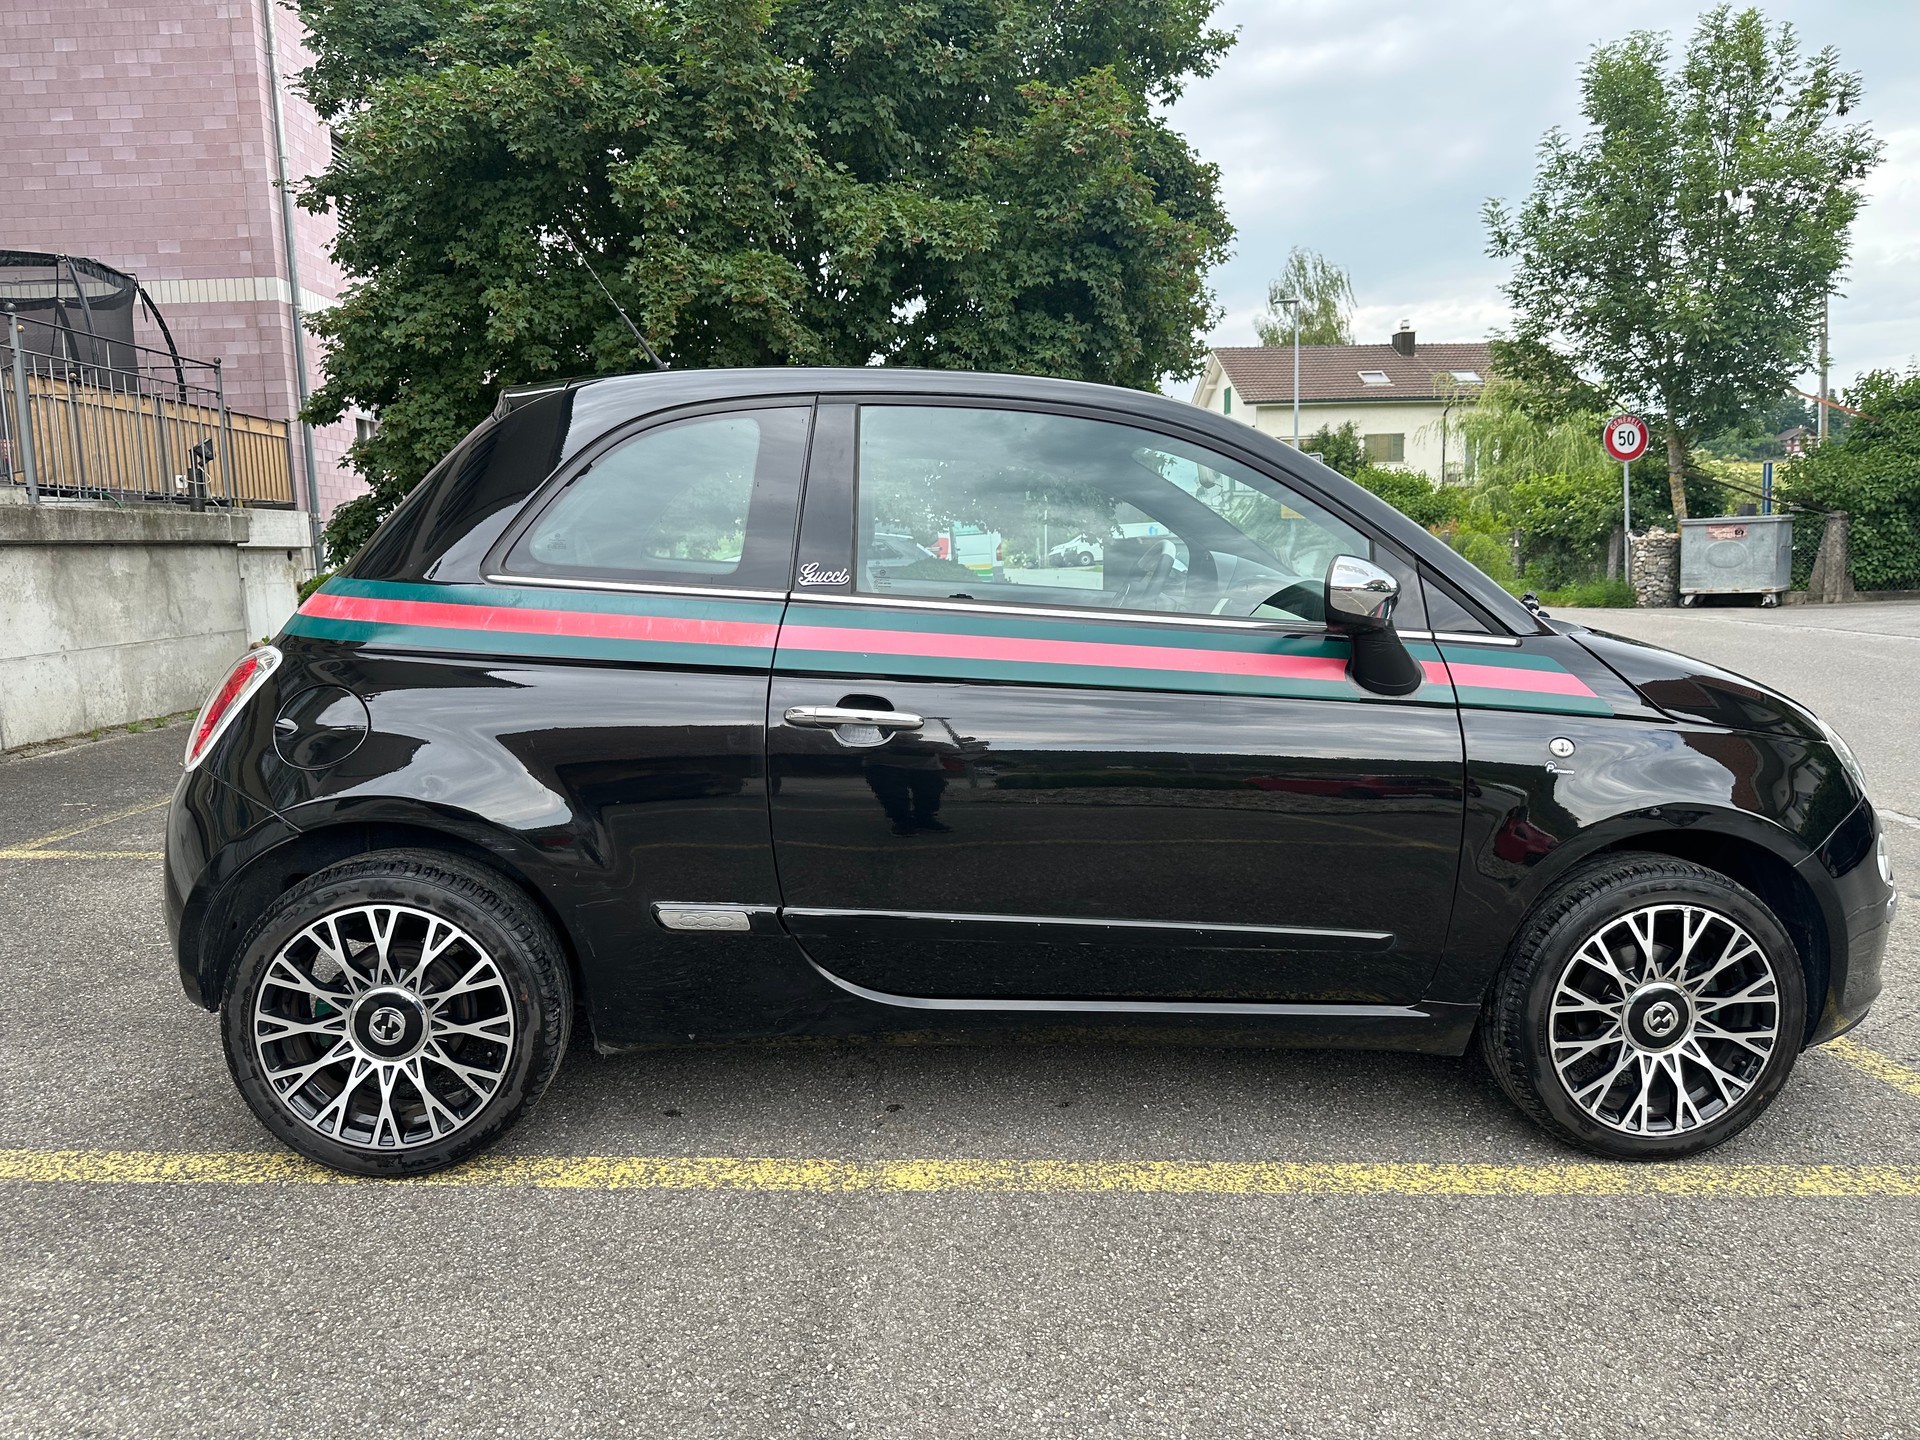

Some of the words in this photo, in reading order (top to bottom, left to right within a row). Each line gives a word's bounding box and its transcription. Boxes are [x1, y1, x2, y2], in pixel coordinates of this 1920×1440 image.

[1610, 416, 1642, 430] GENERELL
[1618, 430, 1635, 446] 50
[798, 562, 850, 586] Gucci
[678, 913, 734, 927] 500
